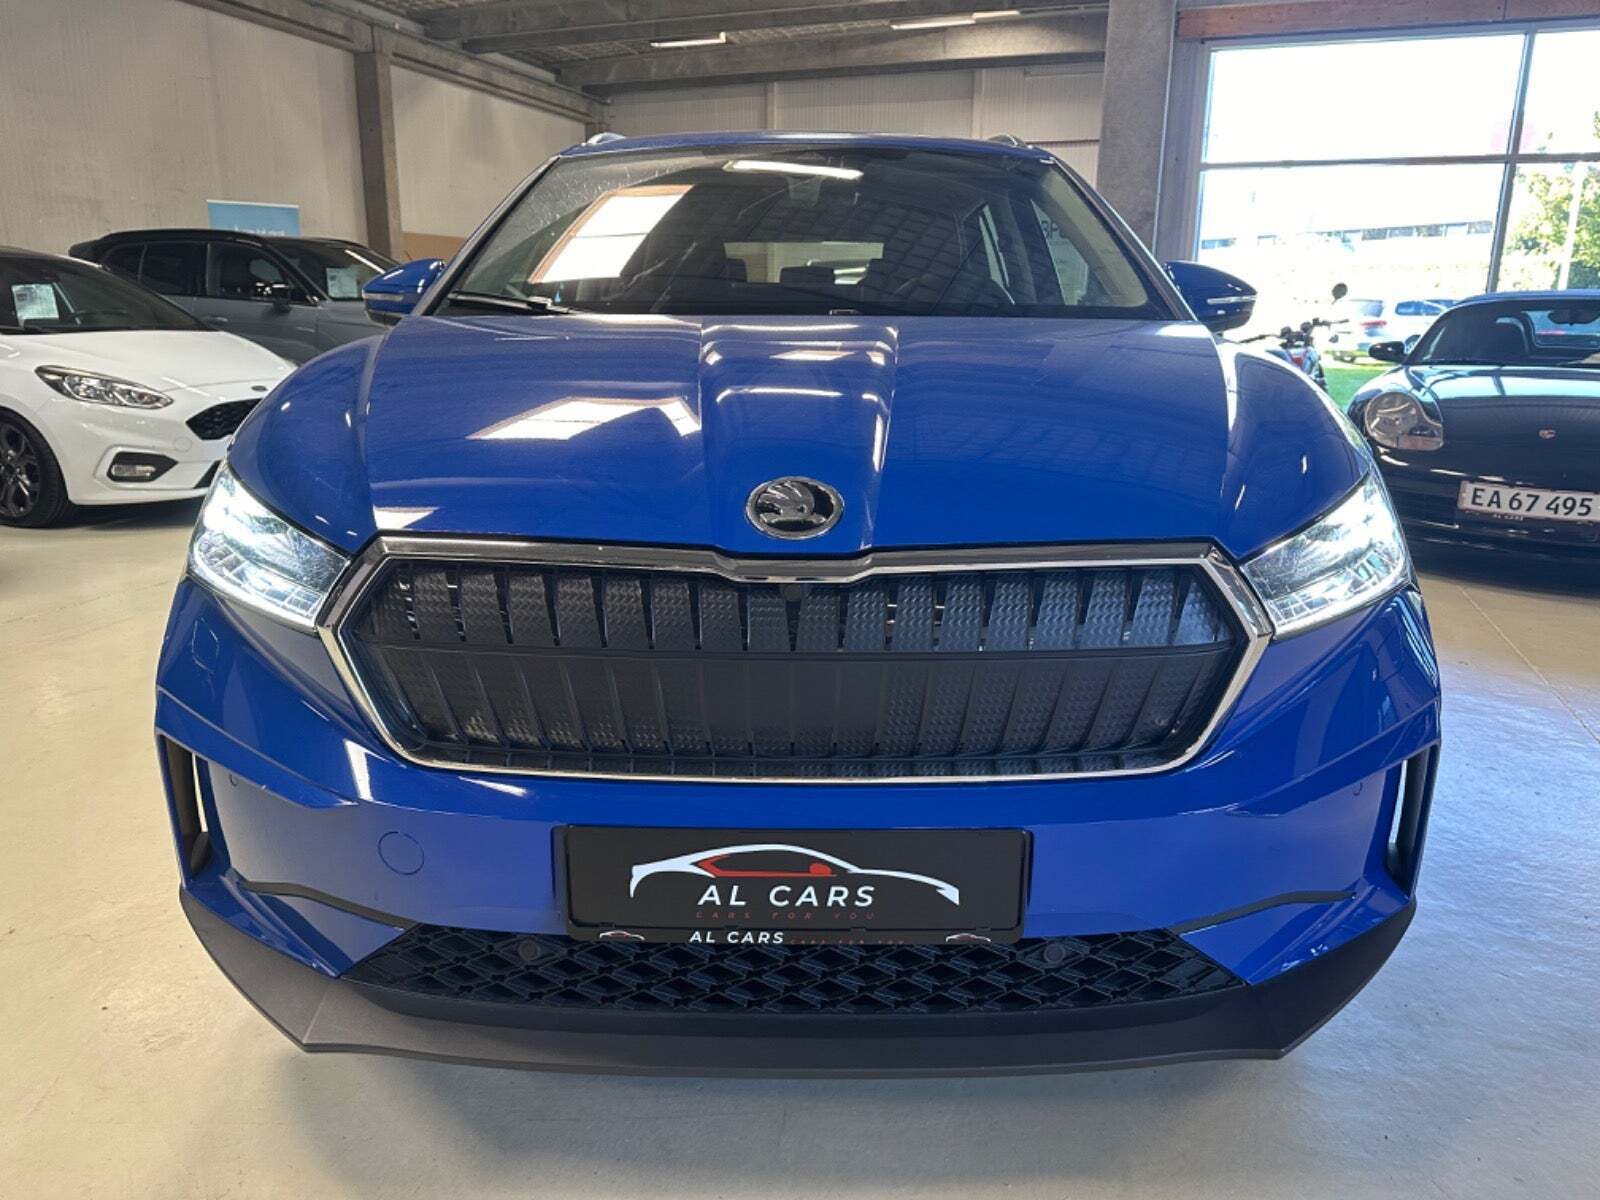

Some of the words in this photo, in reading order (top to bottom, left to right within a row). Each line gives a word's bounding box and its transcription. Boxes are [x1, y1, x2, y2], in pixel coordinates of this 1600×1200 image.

[1471, 487, 1502, 509] EA
[1508, 491, 1541, 513] 67
[1544, 495, 1594, 517] 495
[697, 885, 747, 906] AL
[769, 885, 876, 907] CARS
[696, 911, 750, 920] CARS
[771, 911, 813, 920] FOR
[834, 912, 875, 921] YOU
[689, 930, 716, 944] AL
[726, 931, 785, 944] CARS
